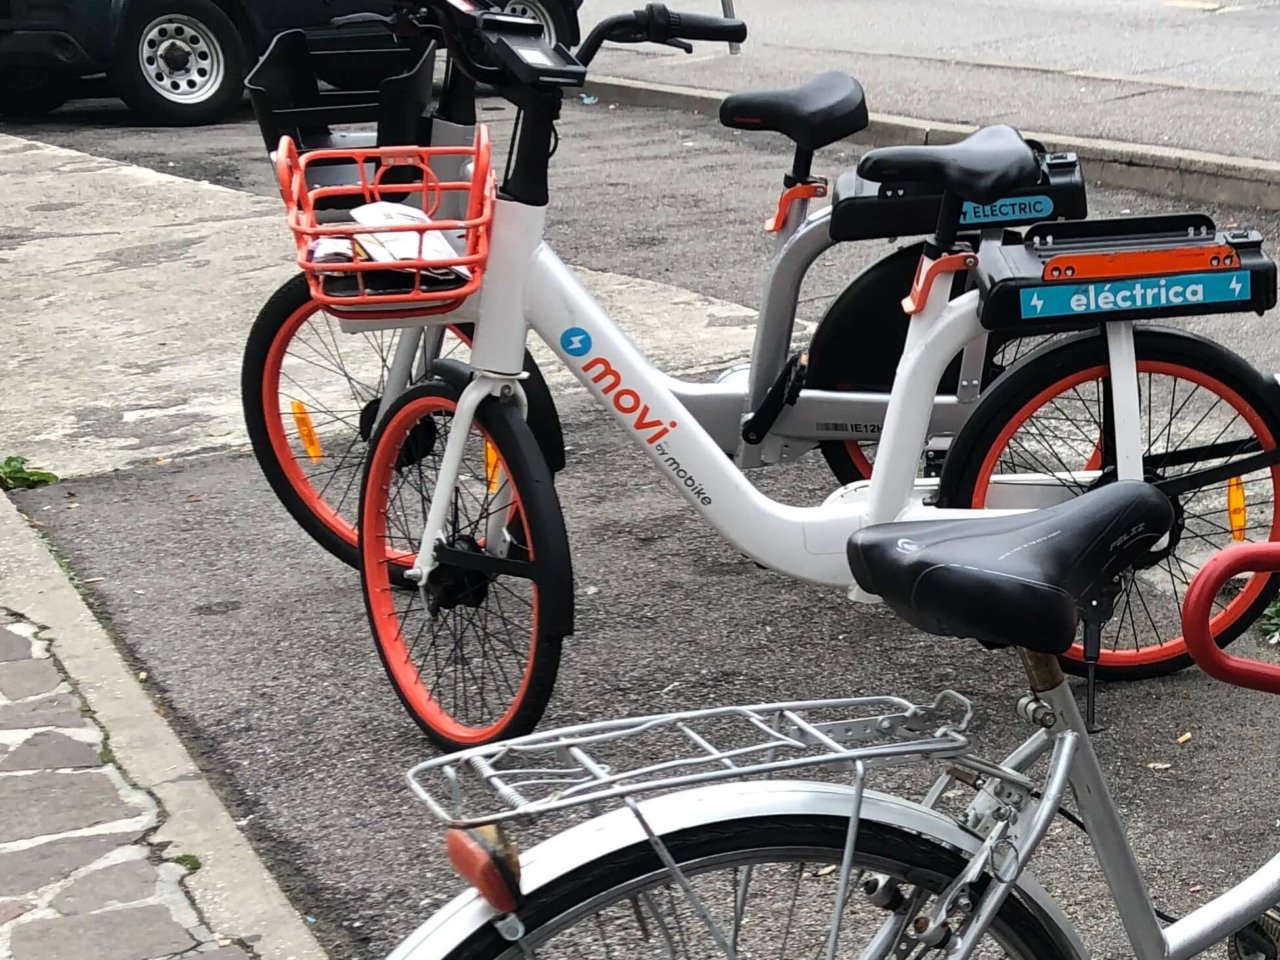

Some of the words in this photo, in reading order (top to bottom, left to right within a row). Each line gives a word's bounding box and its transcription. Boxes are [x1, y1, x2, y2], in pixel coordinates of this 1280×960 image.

[972, 201, 1044, 218] ELECTRIC
[1070, 279, 1204, 312] eléctrica
[581, 357, 678, 445] movi
[655, 443, 669, 456] by
[664, 457, 712, 506] mobike
